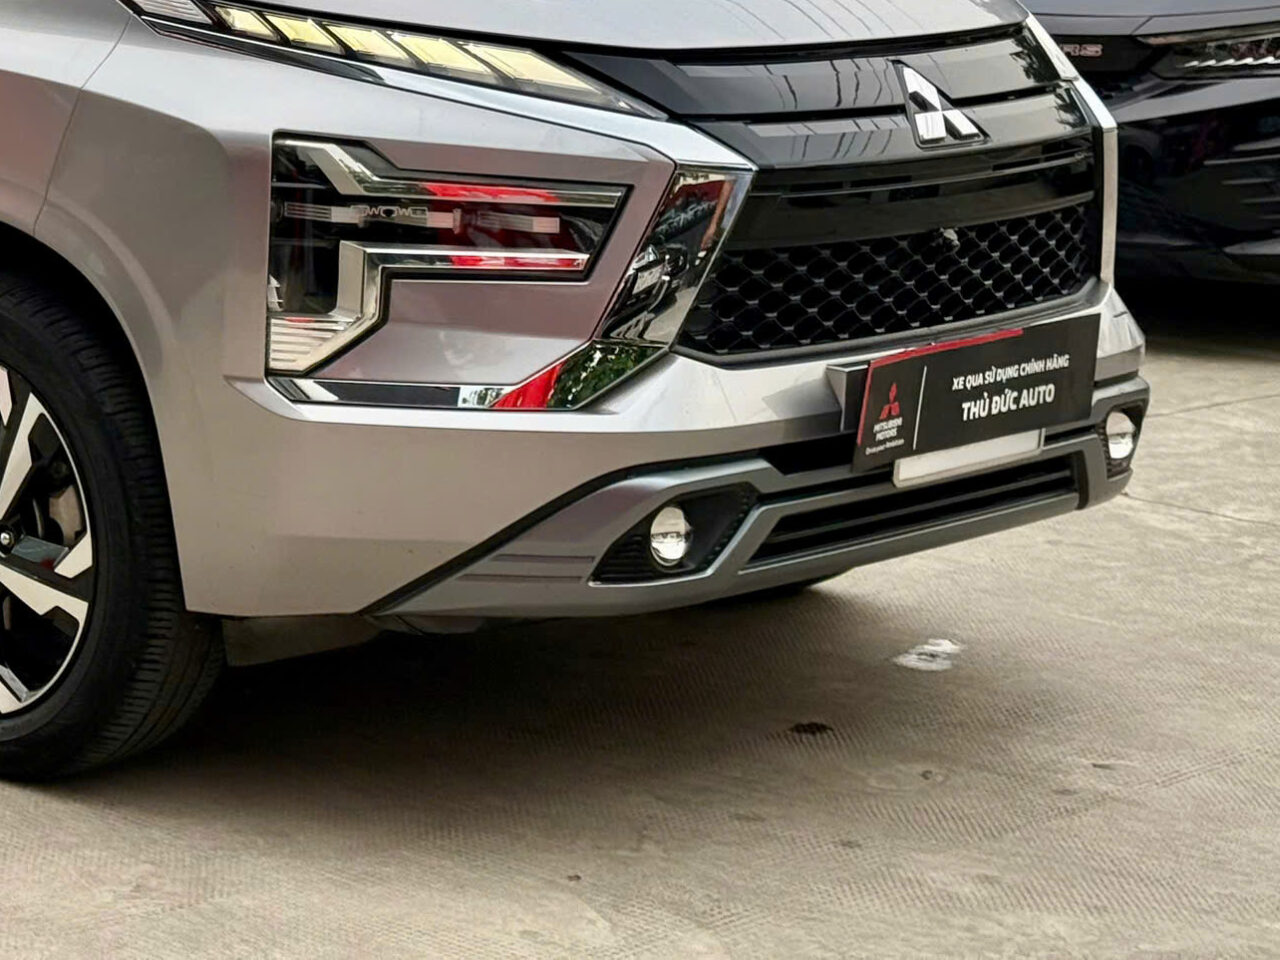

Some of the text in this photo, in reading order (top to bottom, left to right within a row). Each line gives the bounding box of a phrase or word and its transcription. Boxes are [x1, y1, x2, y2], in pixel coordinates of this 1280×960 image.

[952, 376, 965, 391] XE
[965, 372, 983, 390] QUA
[996, 364, 1019, 383] DỤNG
[1020, 358, 1045, 377] CHÍNH
[1046, 353, 1070, 371] HÃNG
[962, 383, 1056, 421] THỦ ĐỨC AUTO
